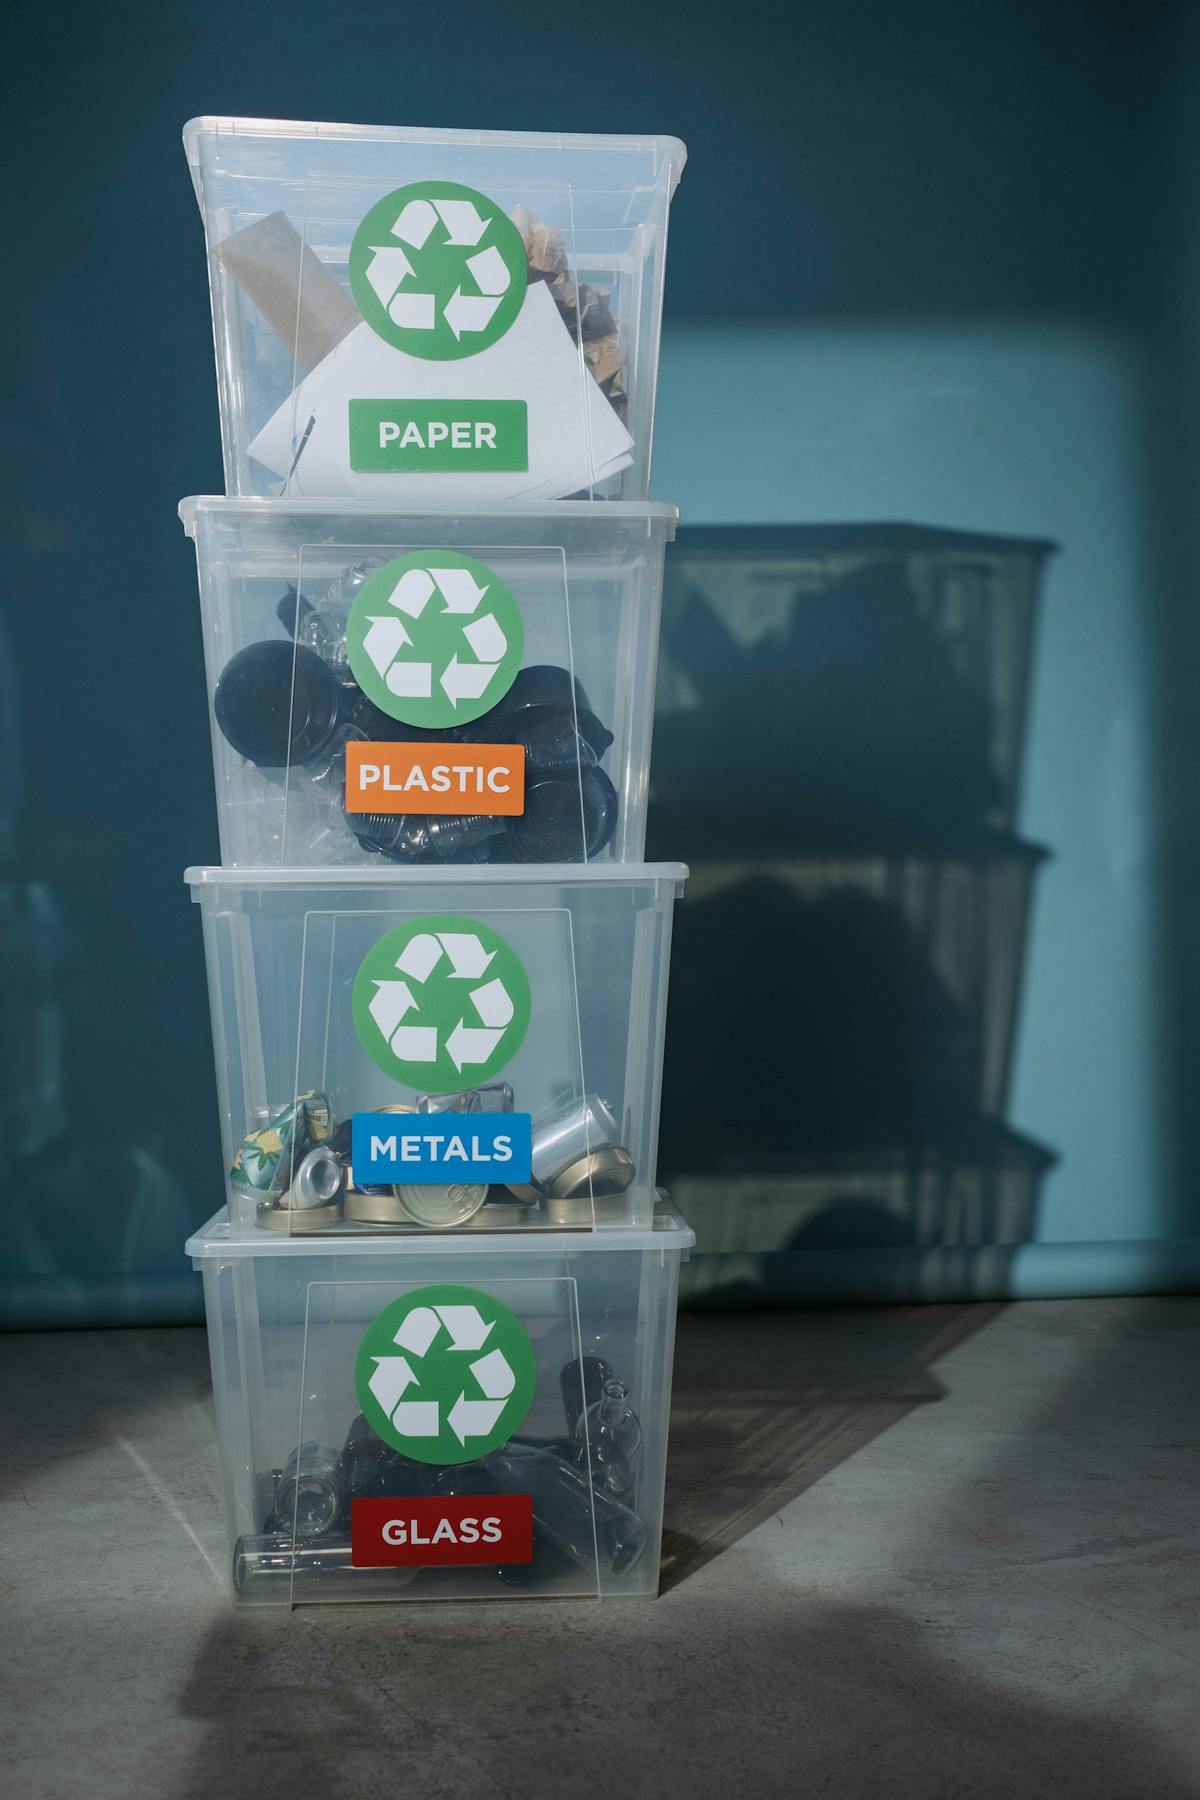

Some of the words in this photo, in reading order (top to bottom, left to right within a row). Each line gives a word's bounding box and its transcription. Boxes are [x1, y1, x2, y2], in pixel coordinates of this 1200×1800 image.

[379, 421, 497, 448] PAPER
[359, 765, 510, 793] PLASTIC
[370, 1135, 513, 1162] METALS
[382, 1517, 502, 1545] GLASS
